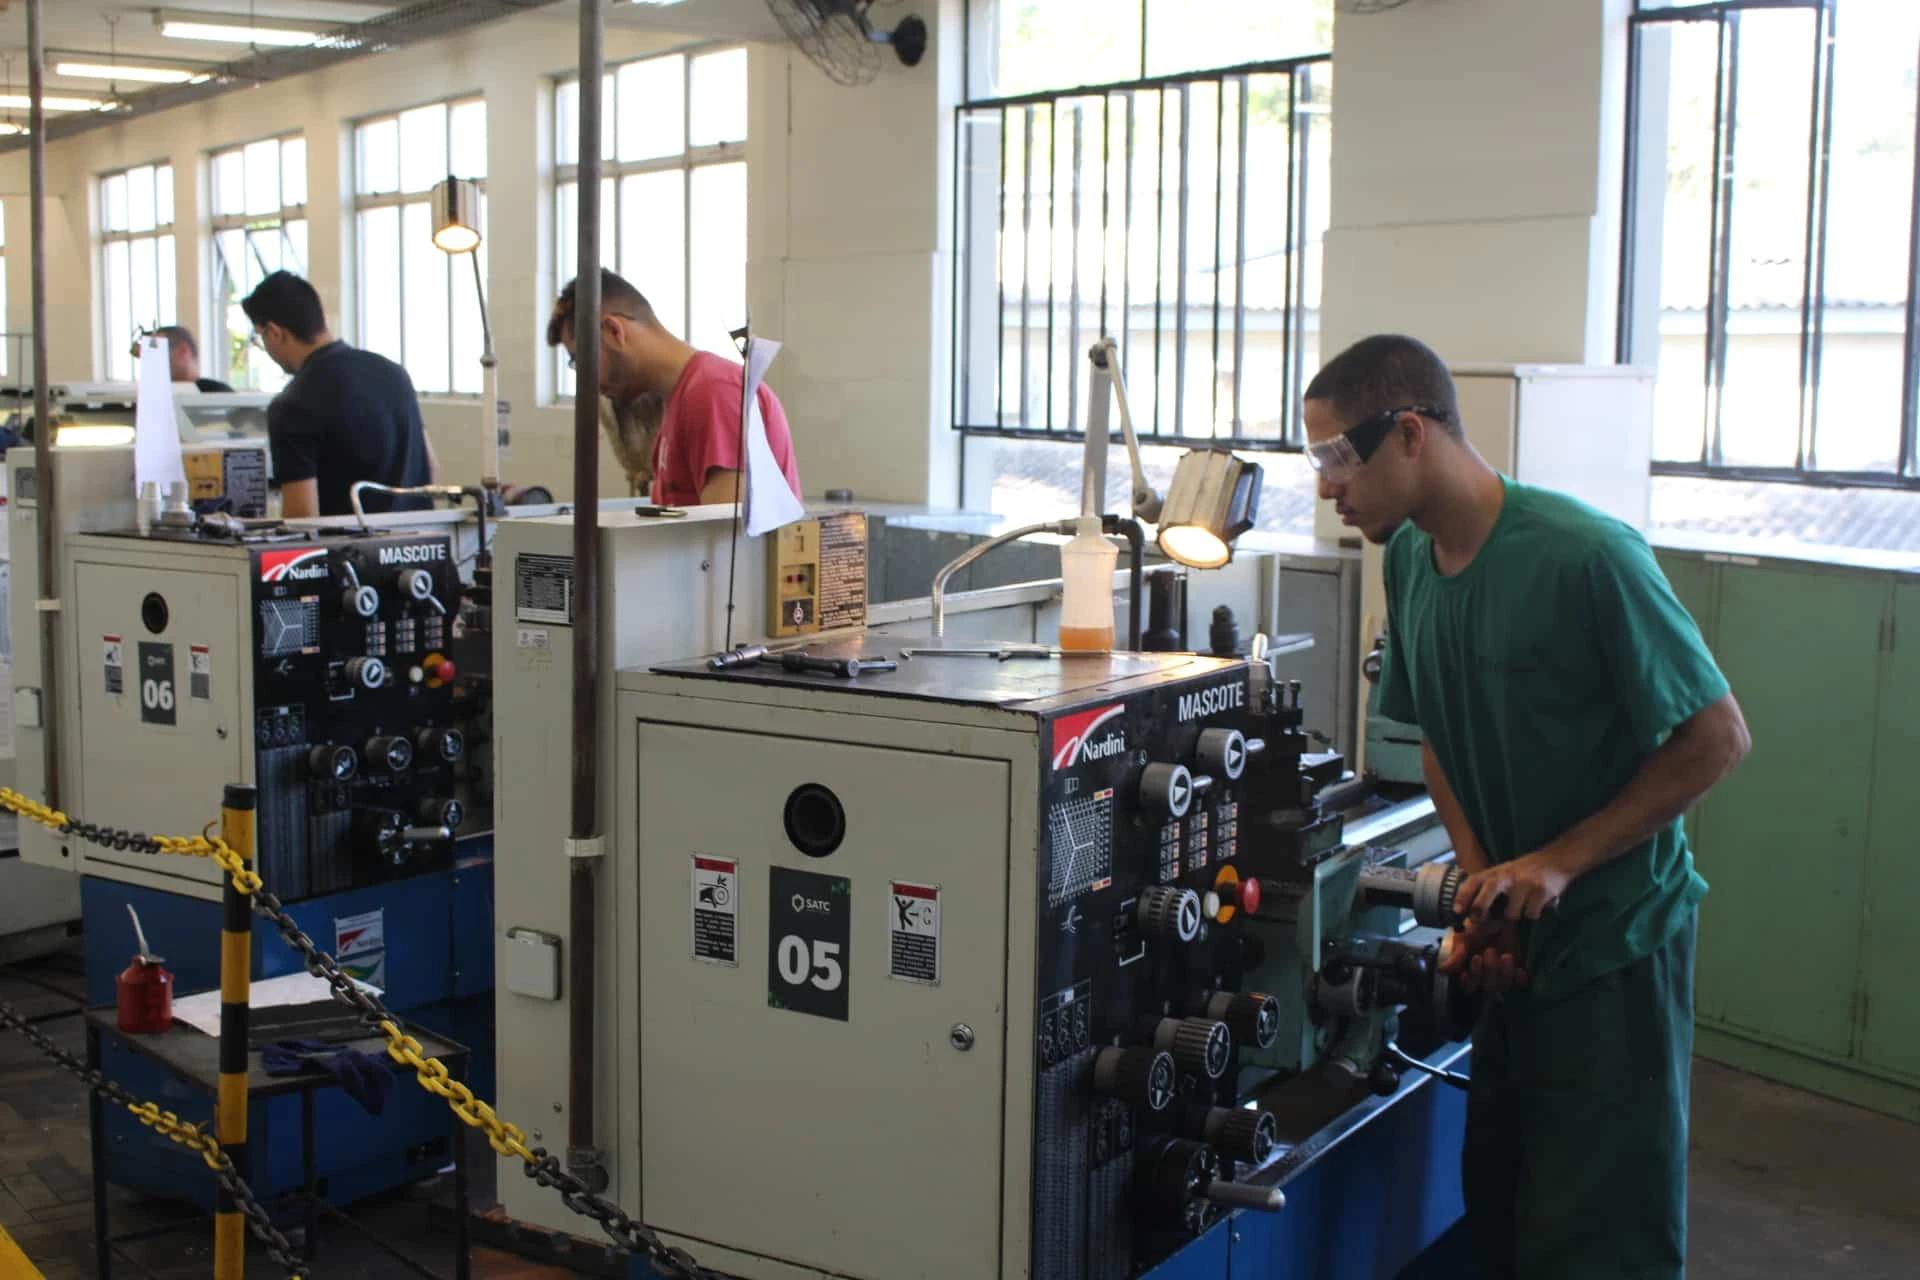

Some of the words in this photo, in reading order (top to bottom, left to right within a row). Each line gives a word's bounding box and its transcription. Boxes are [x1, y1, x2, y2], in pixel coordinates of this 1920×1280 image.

[379, 544, 446, 565] MASCOTE
[289, 563, 329, 581] Nardini
[143, 679, 174, 710] 06
[1178, 681, 1244, 722] MASCOTE
[1082, 730, 1125, 763] Nardini
[806, 898, 830, 911] SATC
[777, 934, 842, 991] 05
